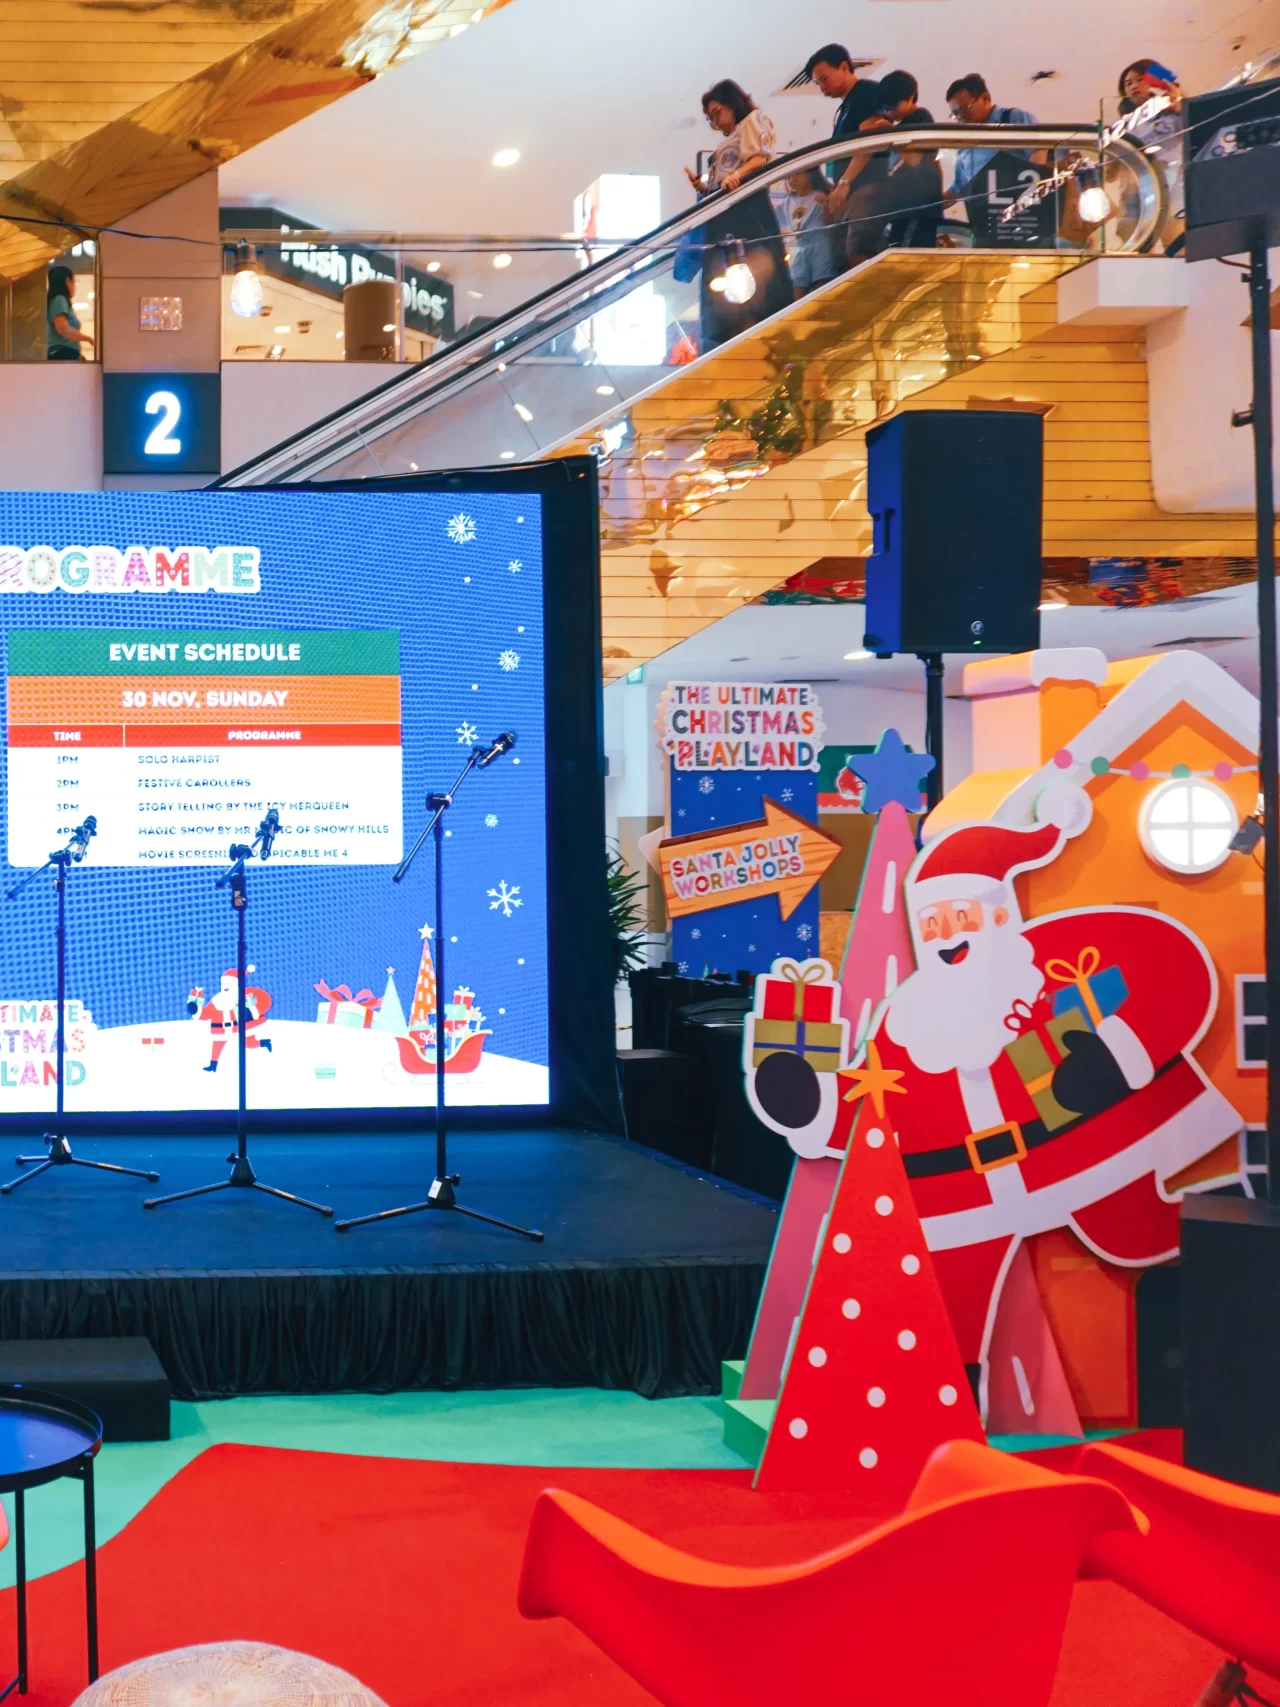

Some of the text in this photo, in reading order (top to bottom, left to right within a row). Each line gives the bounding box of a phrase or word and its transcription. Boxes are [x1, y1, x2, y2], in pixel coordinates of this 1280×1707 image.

[987, 169, 1042, 204] L2
[351, 253, 445, 321] Ppies
[143, 390, 182, 455] 2
[109, 643, 301, 661] EVENT SCHEDULE
[122, 690, 288, 709] 30 NOV, SUNDAY
[675, 686, 809, 705] THE ULTIMATE
[672, 709, 815, 735] CHRISTMAS
[53, 731, 81, 741] TIME
[228, 730, 301, 741] PROGRAMME
[677, 740, 813, 767] PLAYLAND
[57, 755, 79, 764] 1PM
[138, 755, 220, 764] SOLO HARPIST
[56, 779, 79, 788] 2PM
[138, 779, 251, 788] FESTIVE CAROLLERS
[56, 803, 79, 812] 3PM
[138, 801, 349, 811] STORY TELLING BY THE ICY MERQUEEN
[138, 826, 177, 835] MAGIC
[180, 826, 215, 835] SHOW
[217, 826, 231, 834] BY
[234, 826, 251, 834] MR
[296, 826, 310, 834] OF
[314, 825, 355, 834] SNOWY
[358, 825, 389, 833] HILLS
[138, 849, 348, 859] MOVIE SCREENI DPICABLE ME 4
[672, 835, 801, 878] SANTA JOLLY
[675, 855, 802, 898] WORKSHOPS
